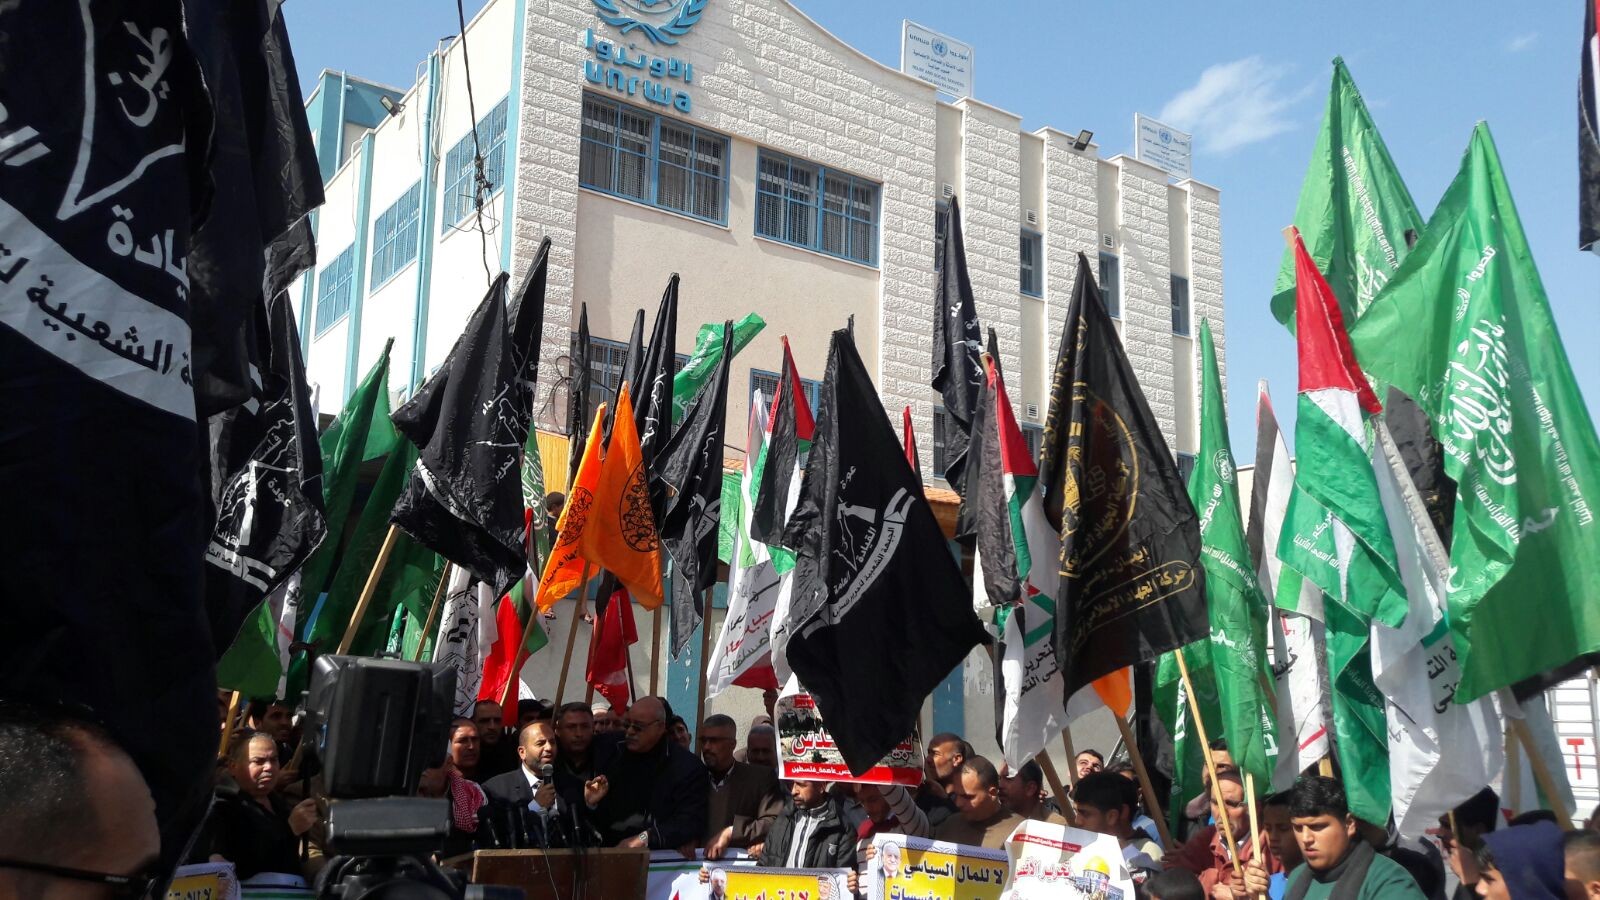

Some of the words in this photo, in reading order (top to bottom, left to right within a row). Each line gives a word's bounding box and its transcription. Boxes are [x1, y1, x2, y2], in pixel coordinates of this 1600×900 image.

[584, 59, 691, 113] unrwa
[26, 274, 172, 375] الشعبية
[855, 526, 877, 563] القيادة
[884, 527, 896, 554] الجبهة
[865, 553, 885, 581] الشعبية
[1156, 568, 1188, 587] حركة
[1123, 577, 1158, 605] الجهاد
[904, 860, 954, 879] السياسي
[957, 865, 990, 884] للمال
[993, 868, 1004, 885] لا
